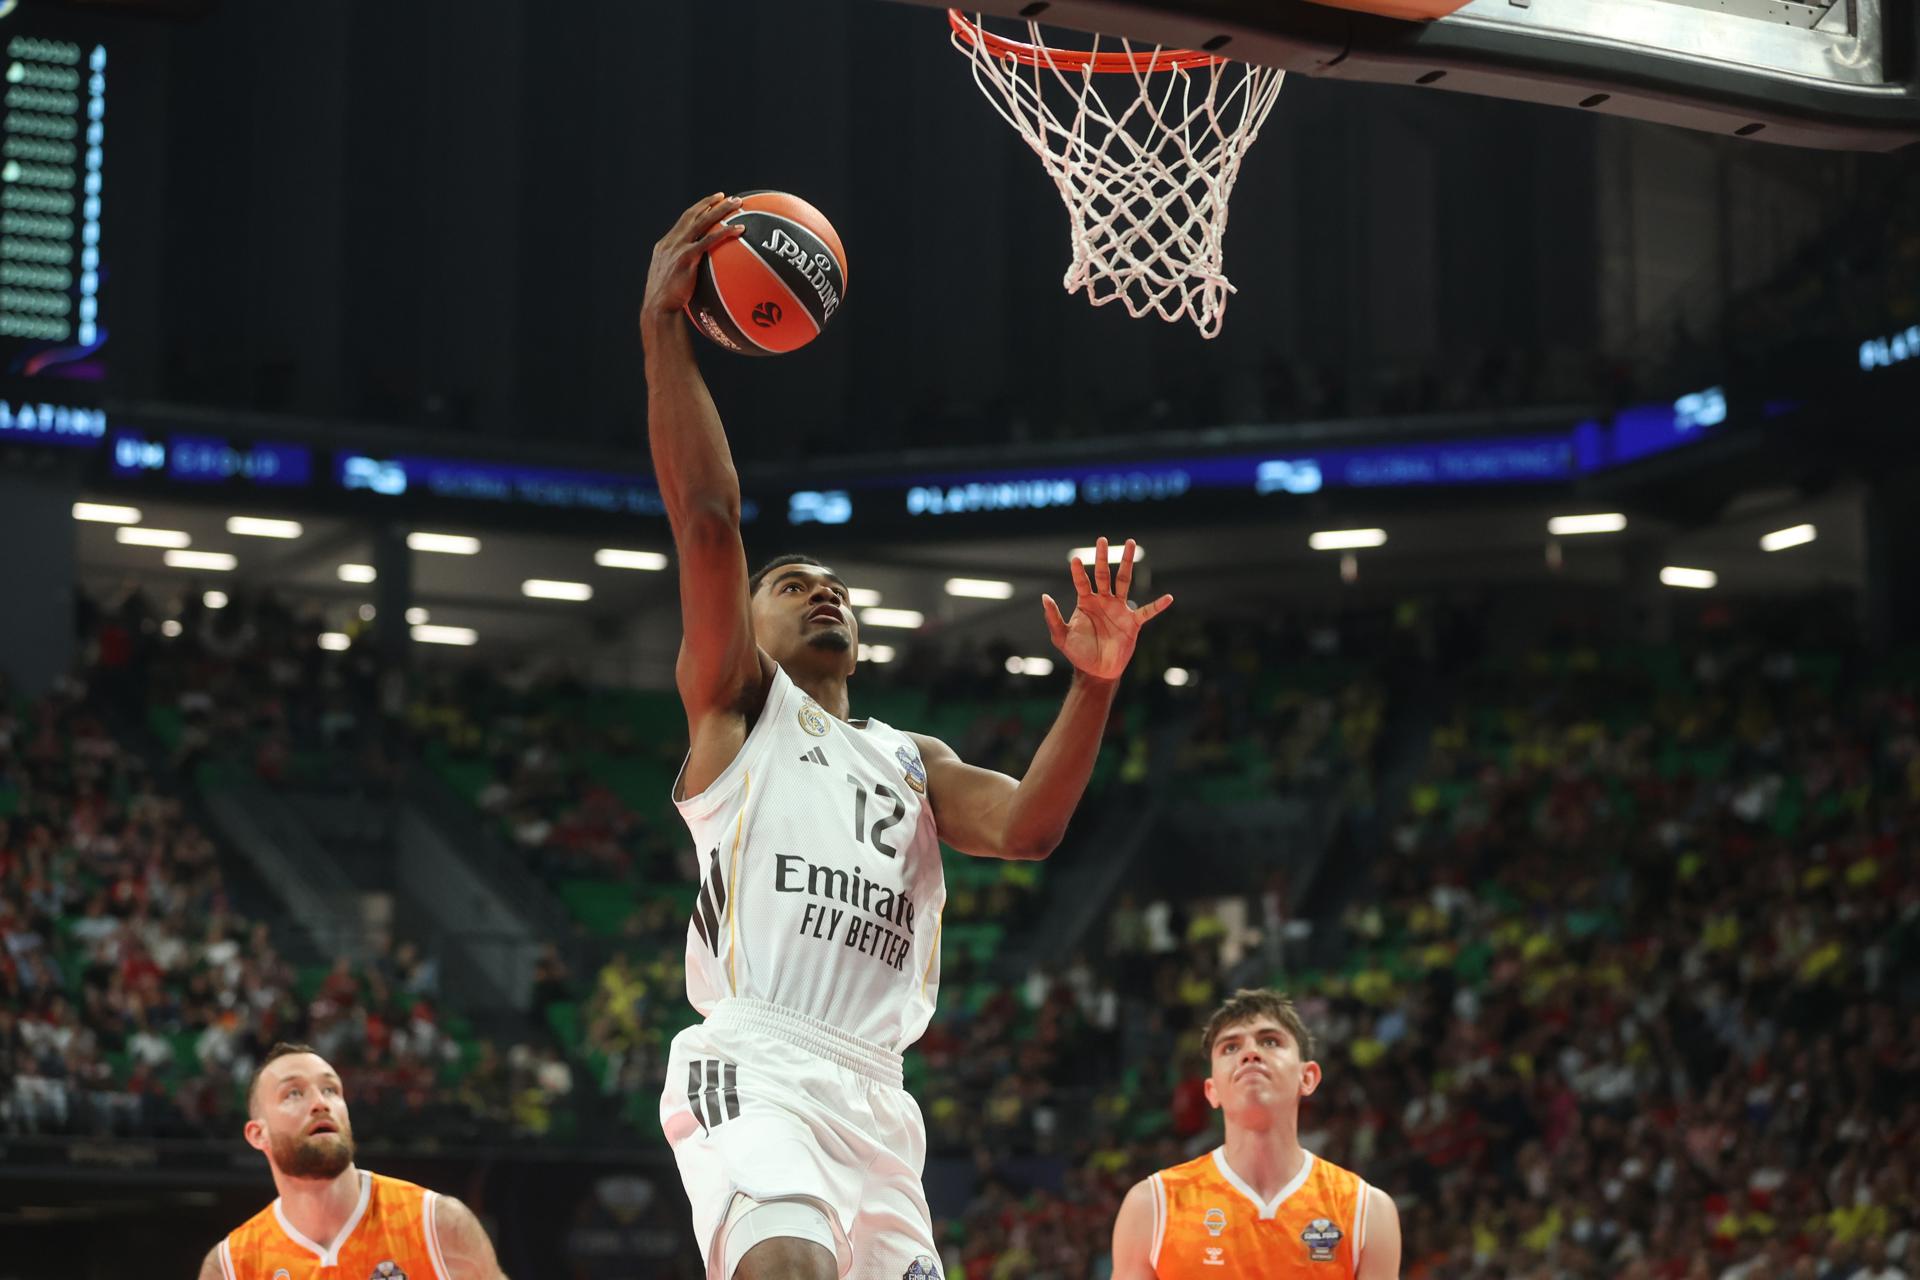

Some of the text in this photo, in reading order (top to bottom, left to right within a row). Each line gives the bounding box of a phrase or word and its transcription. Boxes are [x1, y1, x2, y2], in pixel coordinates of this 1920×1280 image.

[761, 228, 839, 324] SPALDING
[847, 773, 905, 859] 12
[775, 853, 915, 935] Emirate
[800, 903, 910, 971] FLY BETTER
